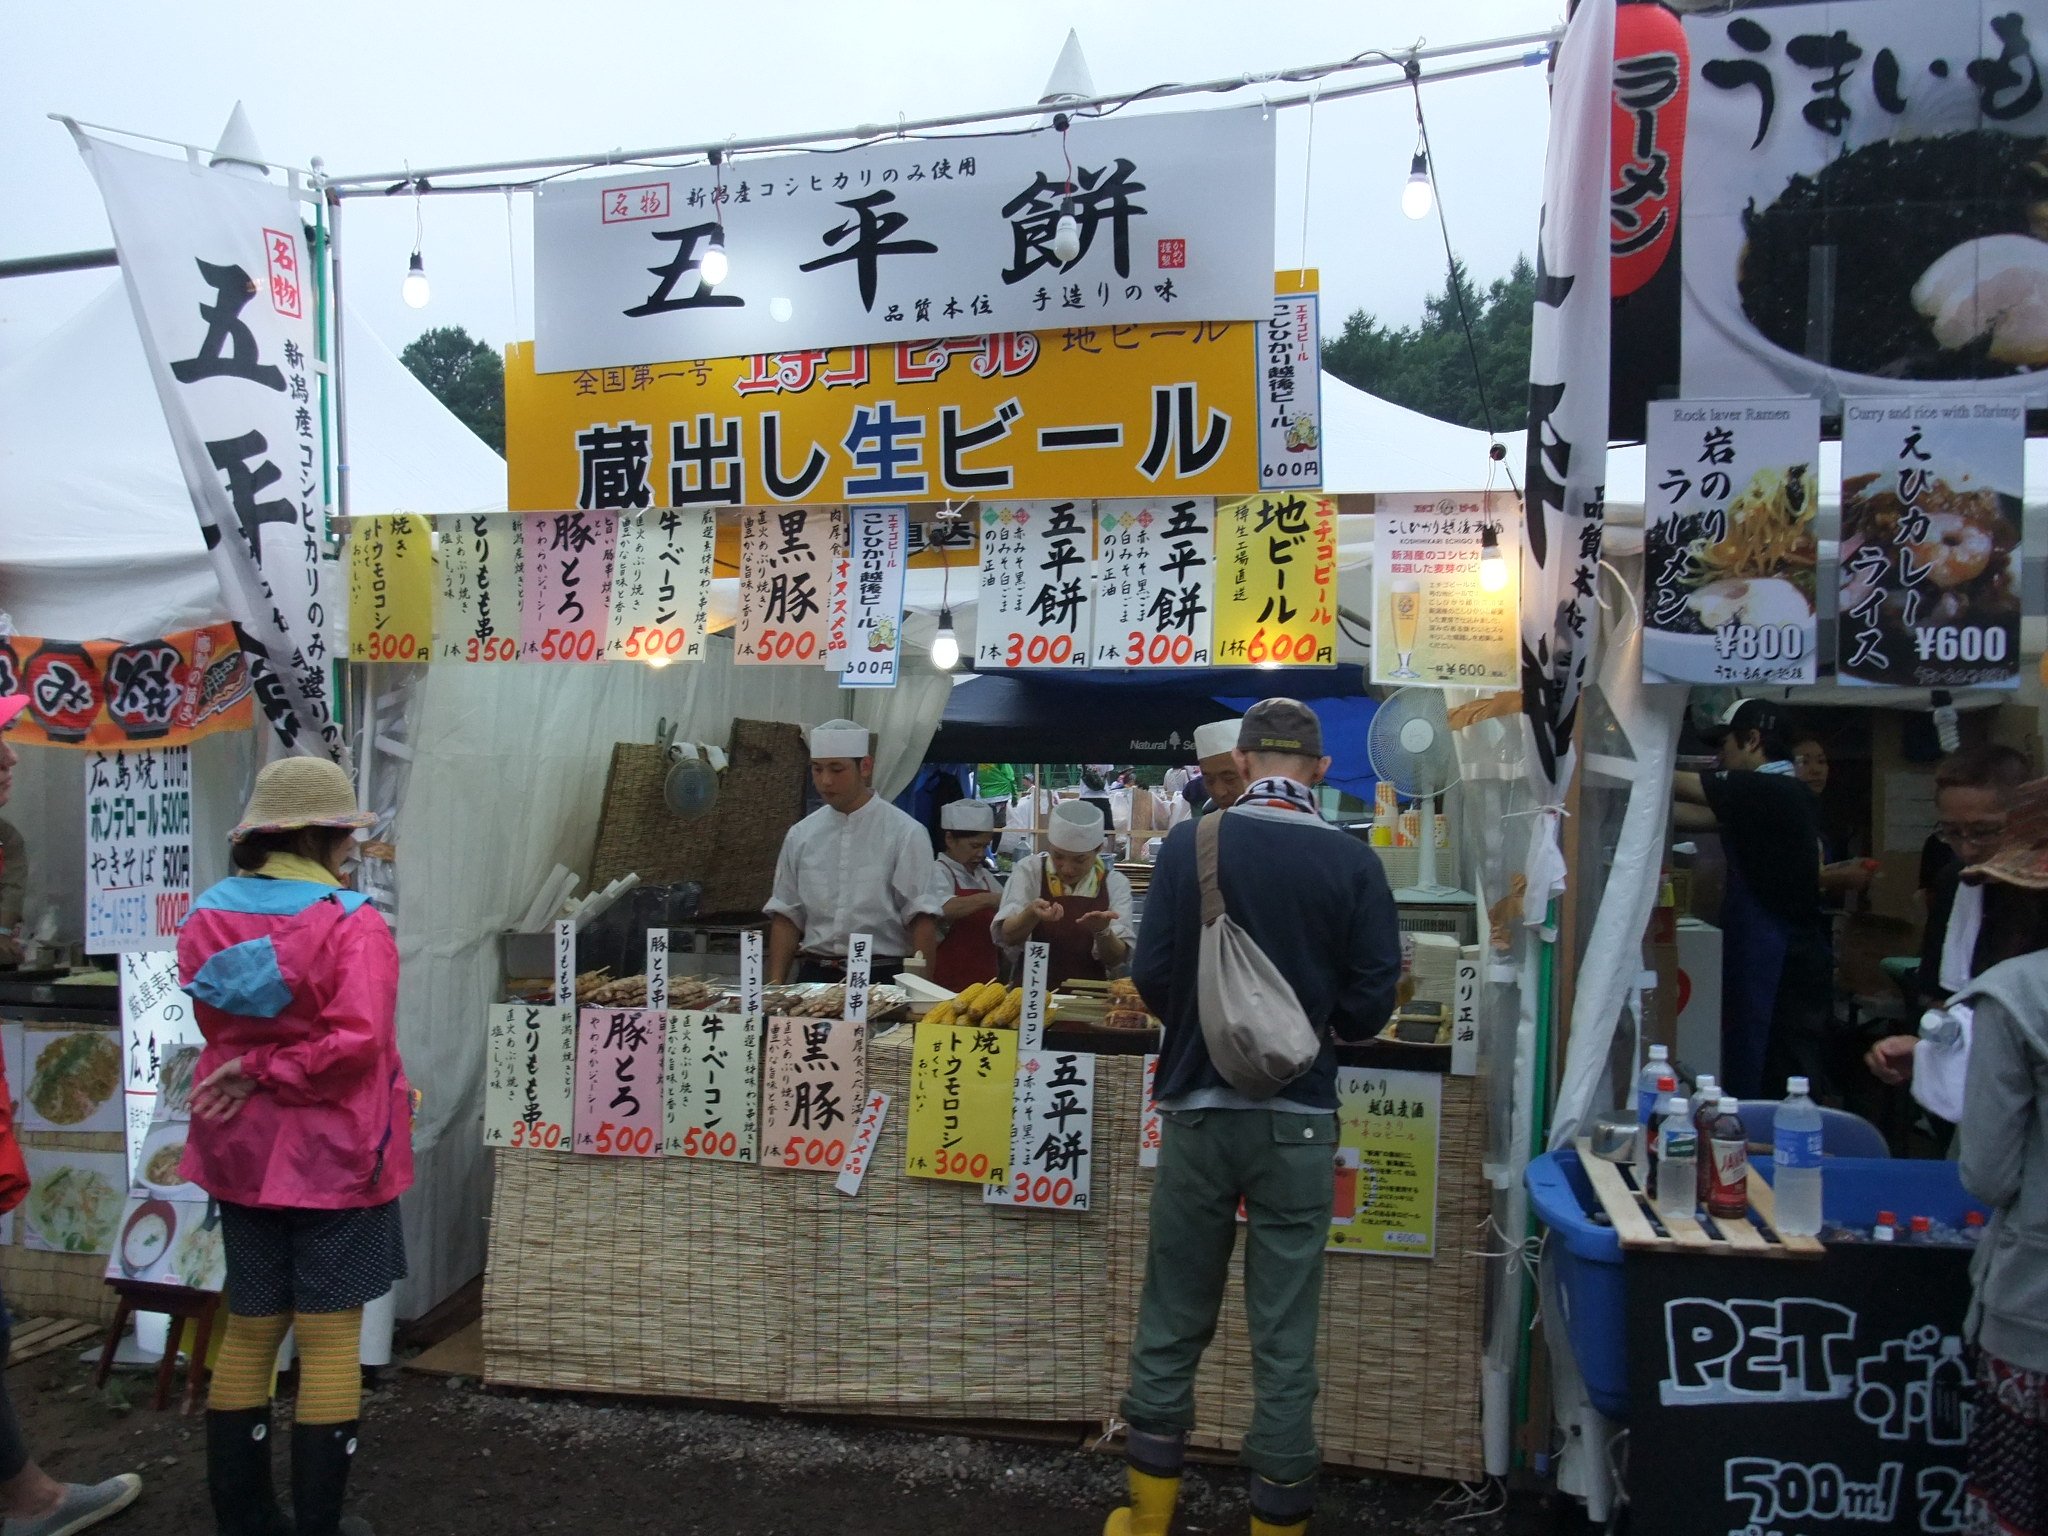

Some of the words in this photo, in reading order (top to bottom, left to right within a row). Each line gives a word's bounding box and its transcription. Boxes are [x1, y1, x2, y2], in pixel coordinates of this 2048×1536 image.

[609, 189, 663, 217] 名物
[686, 156, 977, 210] 新潟産コシヒカリのみ使用
[1612, 52, 1680, 256] ラーメン
[272, 241, 300, 312] 名物
[623, 156, 1148, 319] 五平餅
[884, 294, 993, 323] 品質本位
[1032, 277, 1179, 312] 手造りの味
[1296, 303, 1309, 362] エチゴビール
[573, 360, 713, 396] 全国第一号
[1267, 303, 1296, 428] こしひかり越後ビール
[574, 381, 1232, 511] 蔵出し生ビール
[1673, 408, 1707, 422] Rock
[1746, 408, 1791, 422] Ramen
[1849, 405, 1884, 423] Curry
[1888, 405, 1911, 420] and
[1914, 405, 1936, 420] rice
[1940, 405, 1970, 420] with
[1973, 404, 2021, 423] Shrimp
[1262, 461, 1319, 478] 600円
[1697, 425, 1737, 546] 岩のり
[364, 527, 372, 568] 甘くて
[390, 516, 412, 559] 焼き
[551, 511, 596, 624] 豚とろ
[655, 510, 685, 625] 牛・ベーコン
[763, 509, 820, 624] 黒豚
[857, 511, 884, 629] こしひかり越後ビール
[886, 513, 899, 568] エチゴビール
[982, 529, 998, 588] のり正油
[998, 526, 1012, 613] 白みそ白ごま
[1013, 526, 1026, 612] 赤みそ黒ごま
[1026, 501, 1088, 634] 五平餅
[1101, 533, 1118, 598] のり正油
[1146, 499, 1210, 637] 五平餅
[1233, 504, 1250, 602] 樽生工場直送
[1253, 494, 1311, 625] 地ビール
[1309, 498, 1337, 626] エチゴビール
[1654, 468, 1694, 626] ラーメン
[1896, 425, 1934, 627] えびカレー
[372, 518, 391, 630] トウモロコシ
[471, 514, 495, 646] とりもも串
[828, 559, 852, 651] オススメ品
[1119, 529, 1133, 623] 白みそ白ごま
[1136, 529, 1150, 623] 赤みそ黒ごま
[1847, 546, 1890, 670] ライス
[1714, 623, 1805, 660] ¥800
[1913, 625, 2008, 662] ¥600
[89, 751, 159, 796] 広島焼
[1129, 739, 1167, 750] Natural
[161, 791, 189, 835] 500円
[91, 845, 158, 888] やきそば
[163, 844, 190, 888] 500円
[560, 923, 572, 1004] とりもも串
[650, 935, 668, 1009] 豚とろ串
[746, 933, 759, 1016] 牛・ベーコン串
[849, 941, 869, 1017] 黒豚串
[1025, 944, 1047, 1046] 焼きトウモロコシ
[1457, 965, 1477, 1043] のり正油
[522, 1007, 542, 1131] とりもも串
[602, 1011, 648, 1118] 豚とろ
[701, 1013, 728, 1130] 牛・ベーコン
[788, 1021, 845, 1131] 黒豚
[931, 1039, 943, 1079] 甘くて
[942, 1030, 963, 1149] トウモロコシ
[969, 1030, 1001, 1078] 焼き
[845, 1095, 885, 1175] オススメ品
[1022, 1074, 1036, 1167] 赤みそ黒ごま
[1033, 1054, 1089, 1180] 五平餅
[1663, 1297, 1858, 1396] PET
[1724, 1456, 1904, 1525] 500ml
